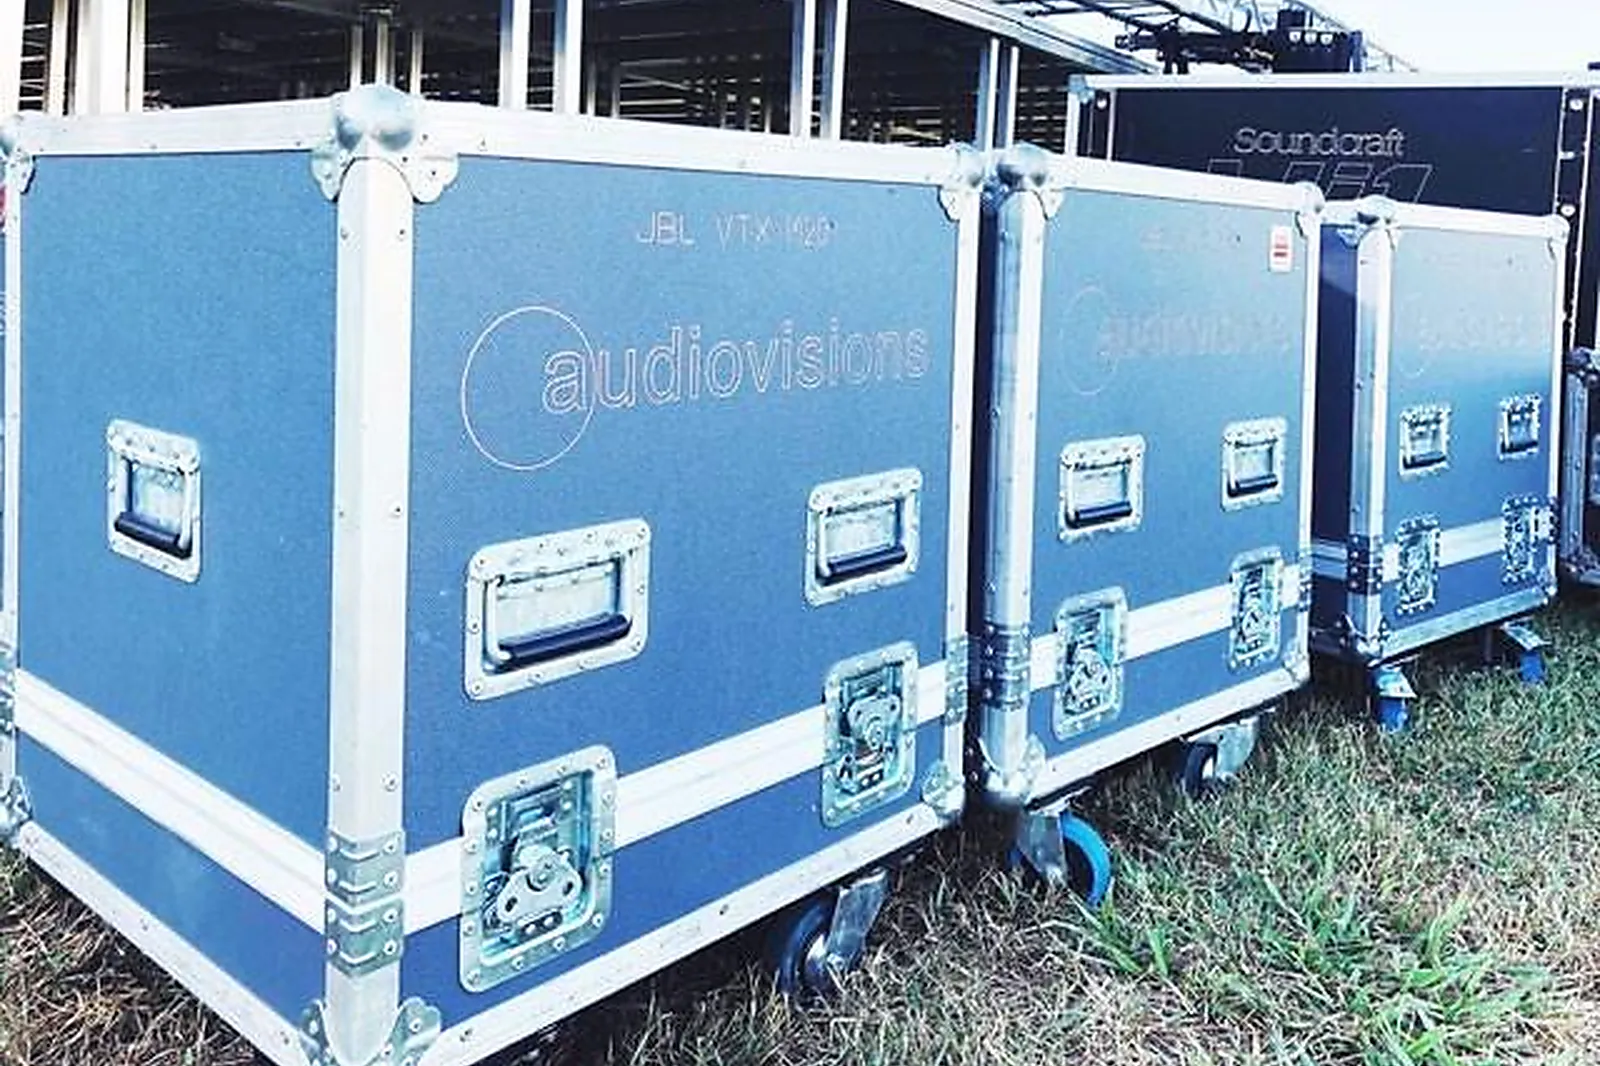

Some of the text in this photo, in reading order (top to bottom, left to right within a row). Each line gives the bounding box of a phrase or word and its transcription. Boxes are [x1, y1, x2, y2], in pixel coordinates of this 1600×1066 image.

[1233, 127, 1404, 156] Soundcraft
[636, 211, 695, 246] JBL
[541, 317, 931, 416] audiovisions
